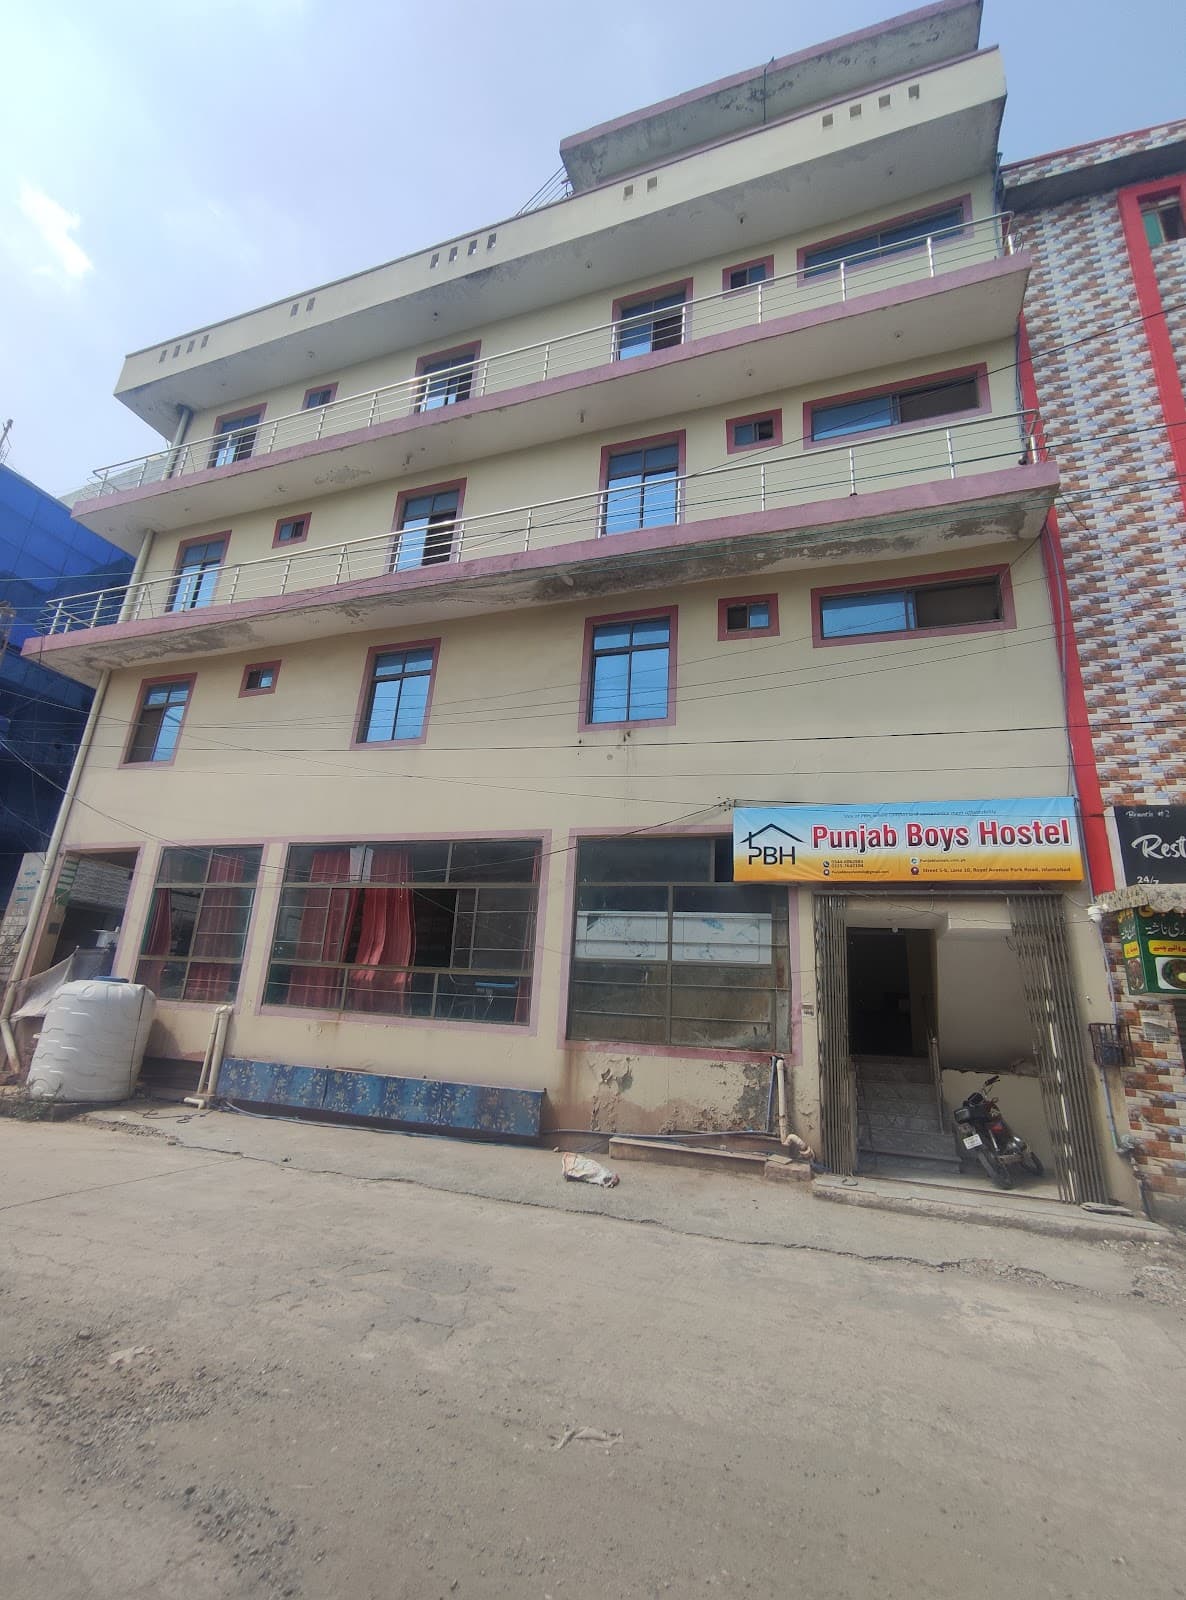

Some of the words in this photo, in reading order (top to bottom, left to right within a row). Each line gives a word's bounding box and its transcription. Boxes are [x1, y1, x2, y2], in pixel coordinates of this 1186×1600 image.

[748, 832, 796, 866] PBH
[812, 823, 898, 854] Punjab
[906, 823, 970, 853] Boys
[979, 818, 1071, 847] Hostel
